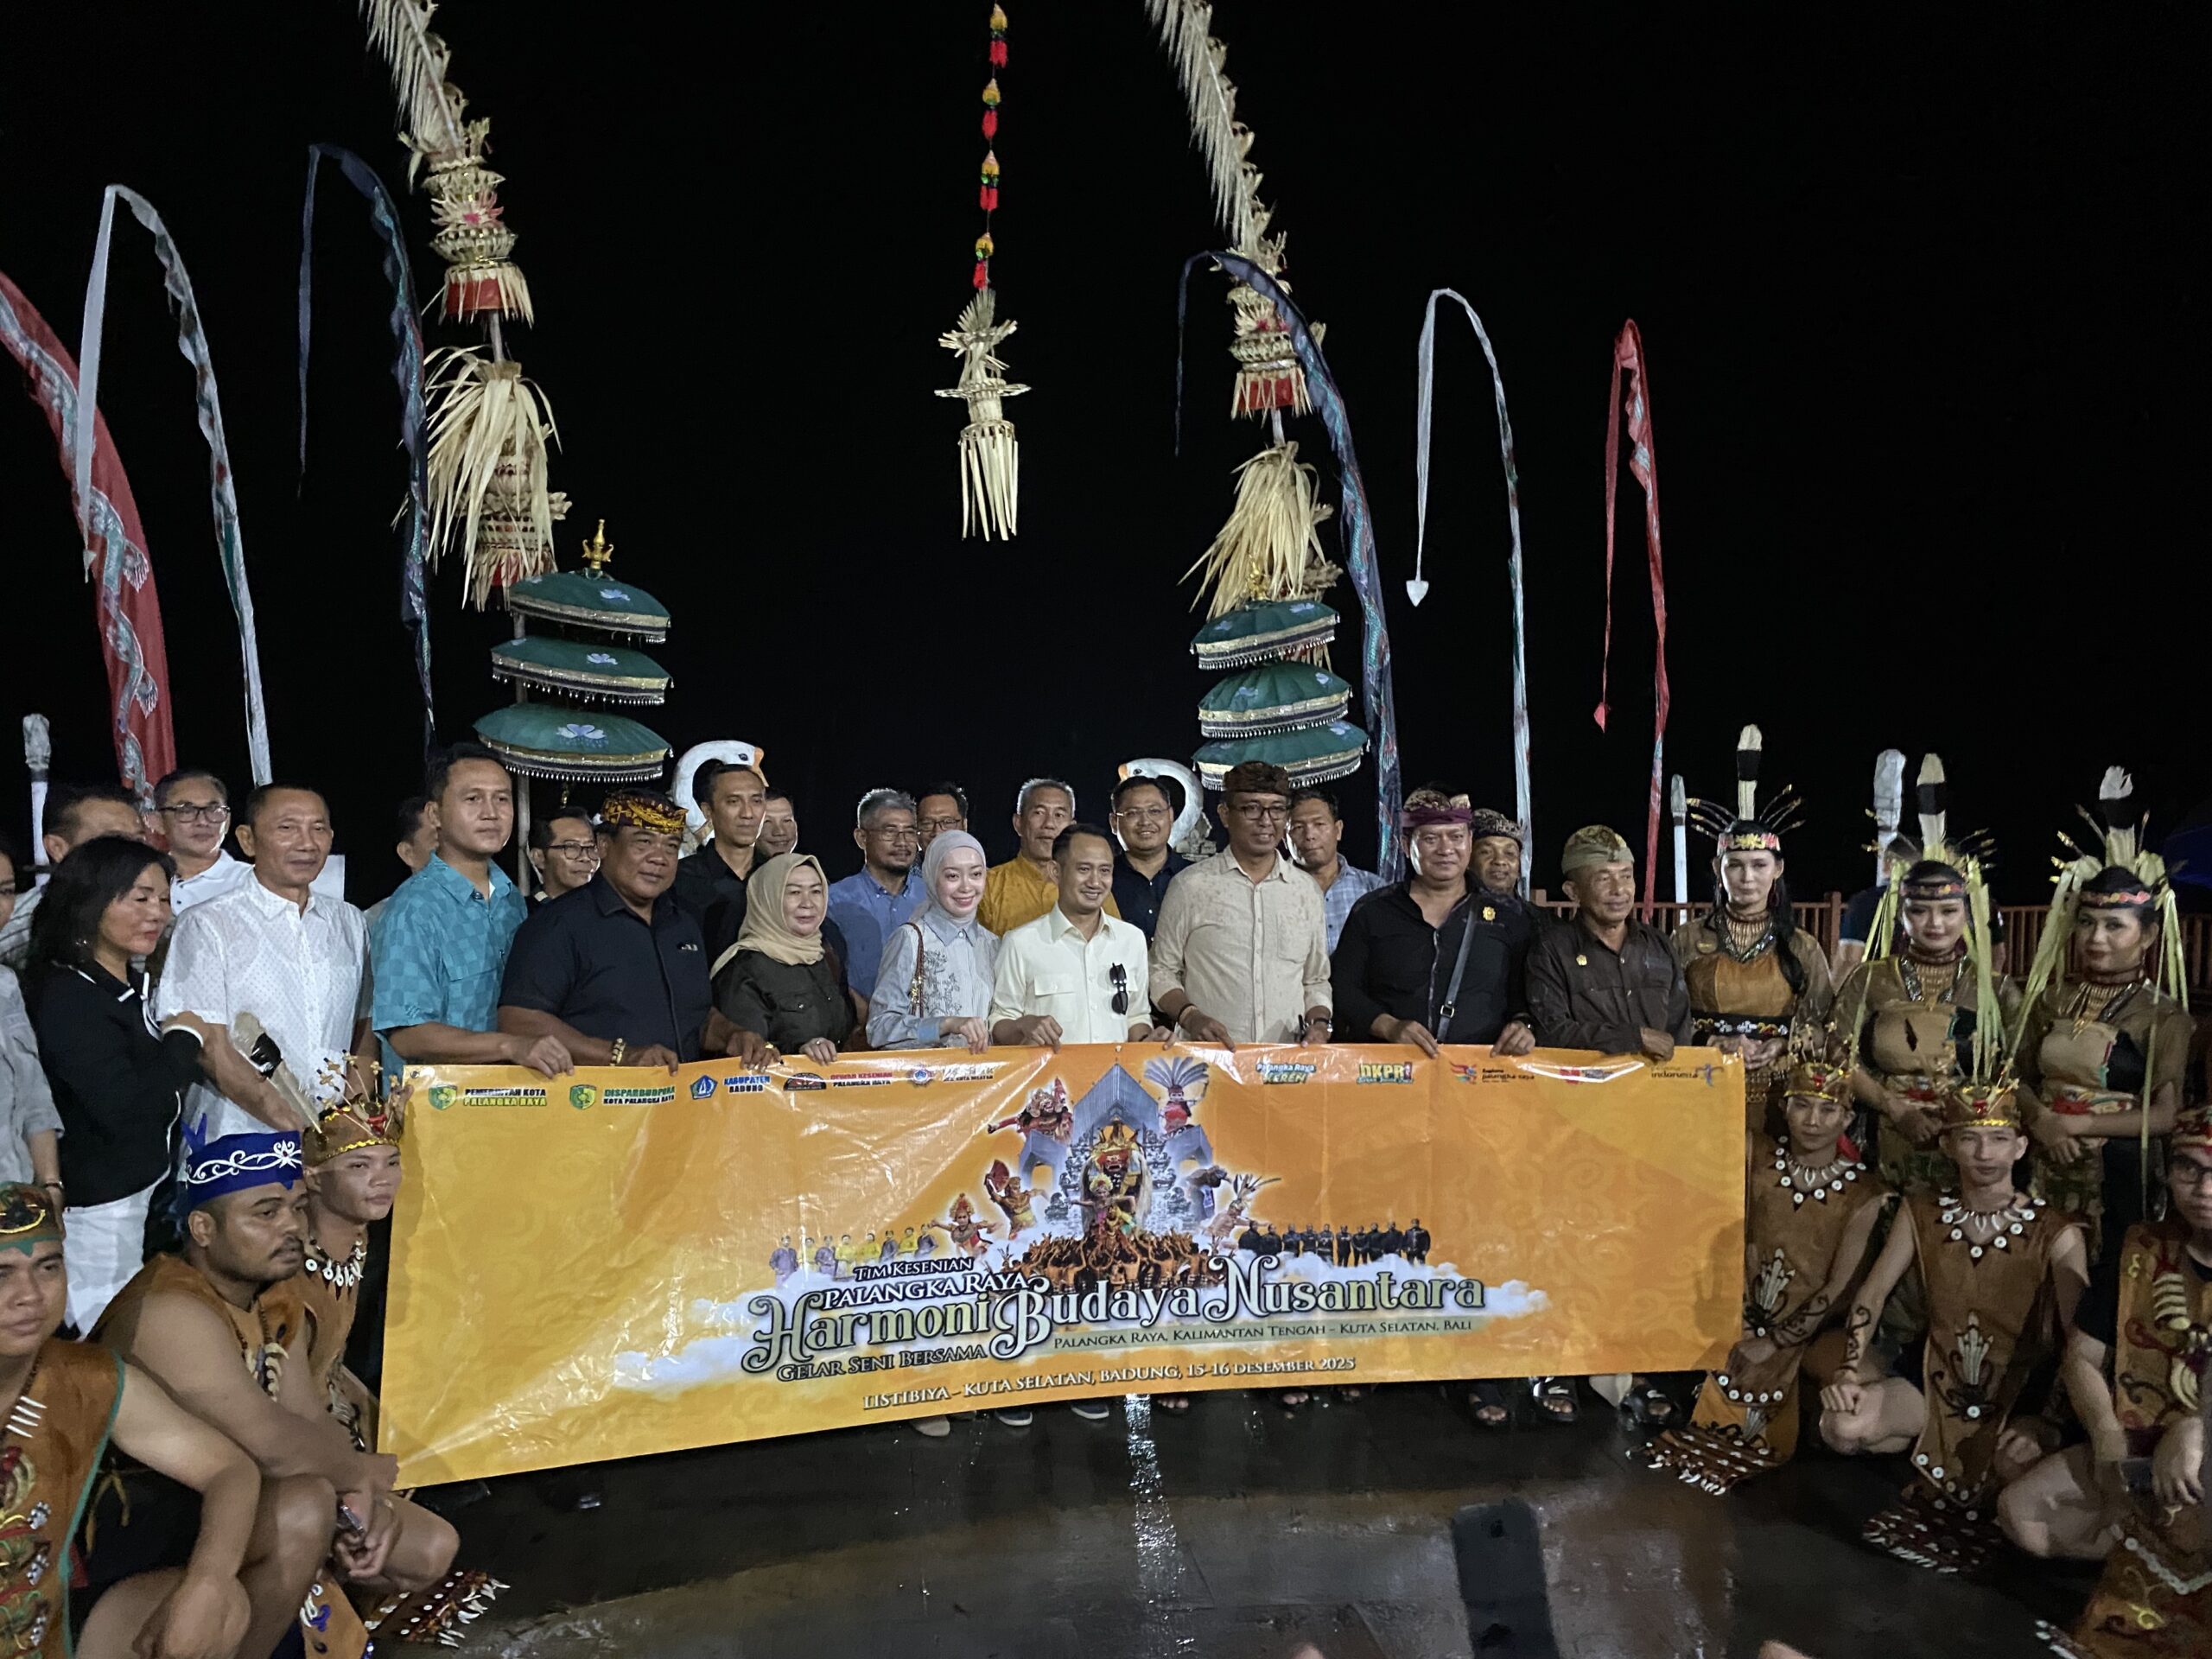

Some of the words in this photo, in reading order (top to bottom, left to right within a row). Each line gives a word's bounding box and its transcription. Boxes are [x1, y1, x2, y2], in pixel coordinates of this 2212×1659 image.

[724, 1076, 771, 1085] KABUPATEN
[1294, 1063, 1315, 1073] Raya
[464, 1096, 518, 1106] PALANGKA
[519, 1096, 547, 1106] RAYA
[523, 1088, 546, 1096] KOTA
[854, 1265, 890, 1282] TIM
[892, 1257, 975, 1277] KESENIAN
[823, 1278, 960, 1310] PALANGKA
[963, 1271, 1028, 1294] RAYA
[741, 1291, 990, 1373] Harmoni
[989, 1274, 1200, 1360] Budaya
[1202, 1254, 1485, 1323] Nusantara
[1053, 1333, 1127, 1349] PALANGKA
[1173, 1326, 1264, 1340] KALIMANTAN
[1268, 1325, 1325, 1337] TENGAH
[1340, 1322, 1376, 1334] KUTA
[1444, 1319, 1472, 1331] BALI
[777, 1361, 846, 1382] GELAR
[848, 1353, 893, 1374] SENI
[899, 1344, 988, 1367] BERSAMA
[863, 1386, 950, 1410] LISTIBIYA
[963, 1380, 1014, 1397] KUTA
[1015, 1370, 1096, 1392] SELATAN,
[1099, 1364, 1183, 1382] BADUNG,
[1233, 1360, 1315, 1375] DESEMBER
[1319, 1357, 1356, 1371] 2025
